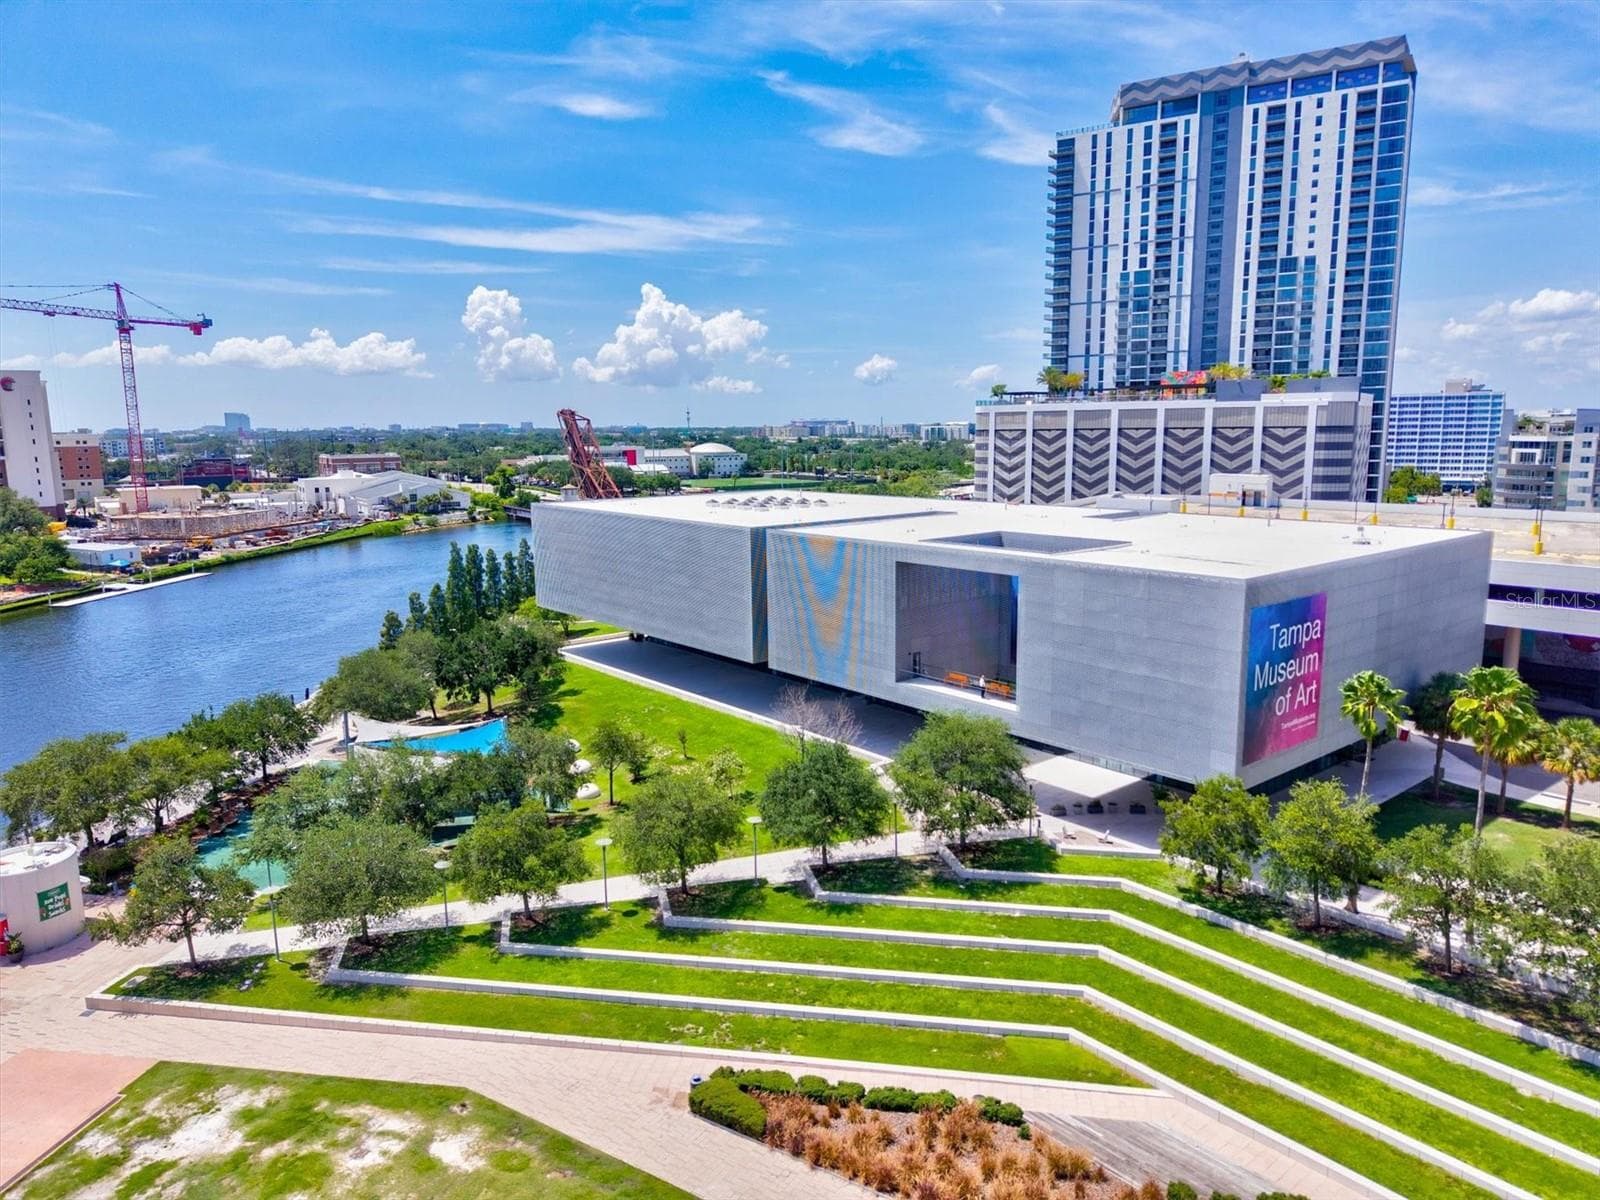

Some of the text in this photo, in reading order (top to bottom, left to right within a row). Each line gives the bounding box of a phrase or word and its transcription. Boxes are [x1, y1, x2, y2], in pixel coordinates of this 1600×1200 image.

[1269, 618, 1321, 651] Tampa
[1254, 652, 1319, 691] Museum
[1275, 679, 1317, 716] of Art
